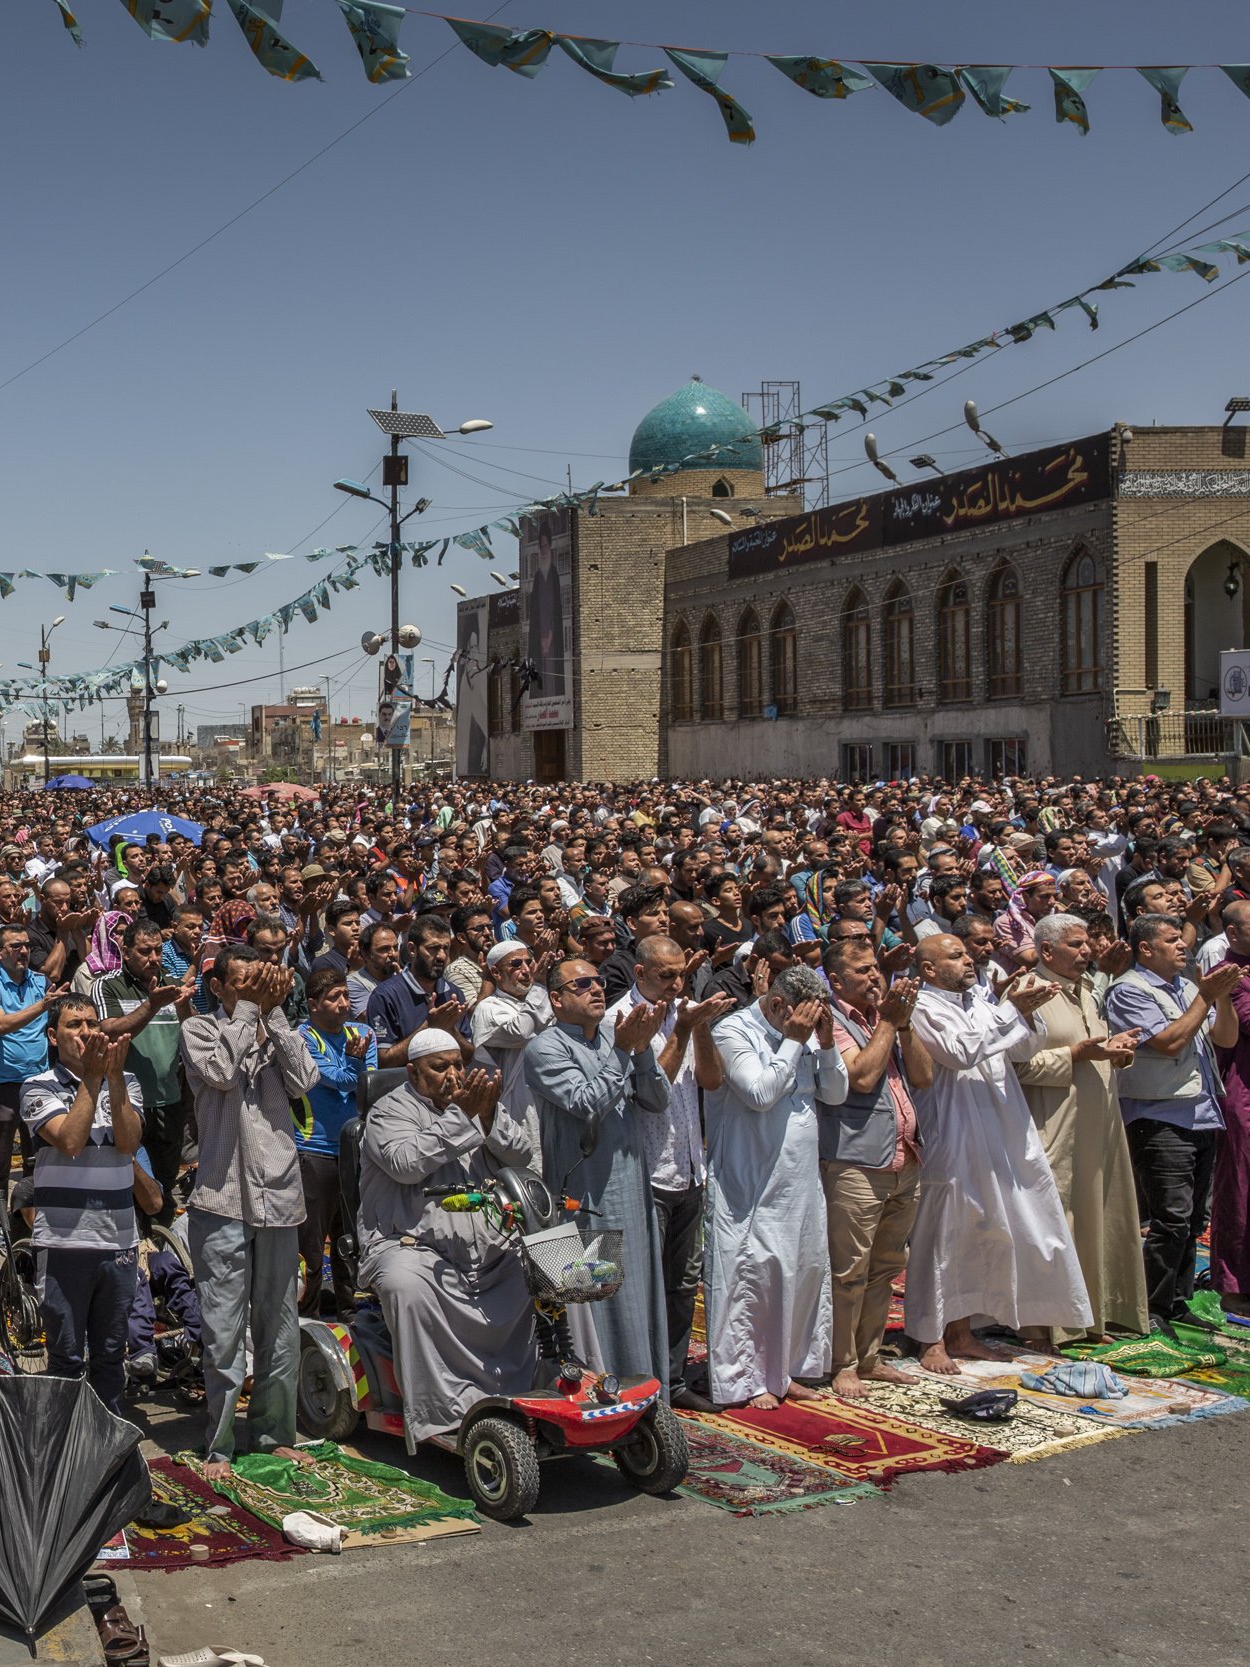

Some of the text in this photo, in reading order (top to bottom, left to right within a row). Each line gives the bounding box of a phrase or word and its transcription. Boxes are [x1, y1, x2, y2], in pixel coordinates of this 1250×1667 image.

[942, 447, 1089, 526] محمد الصدر
[778, 498, 870, 562] محمد الصدر
